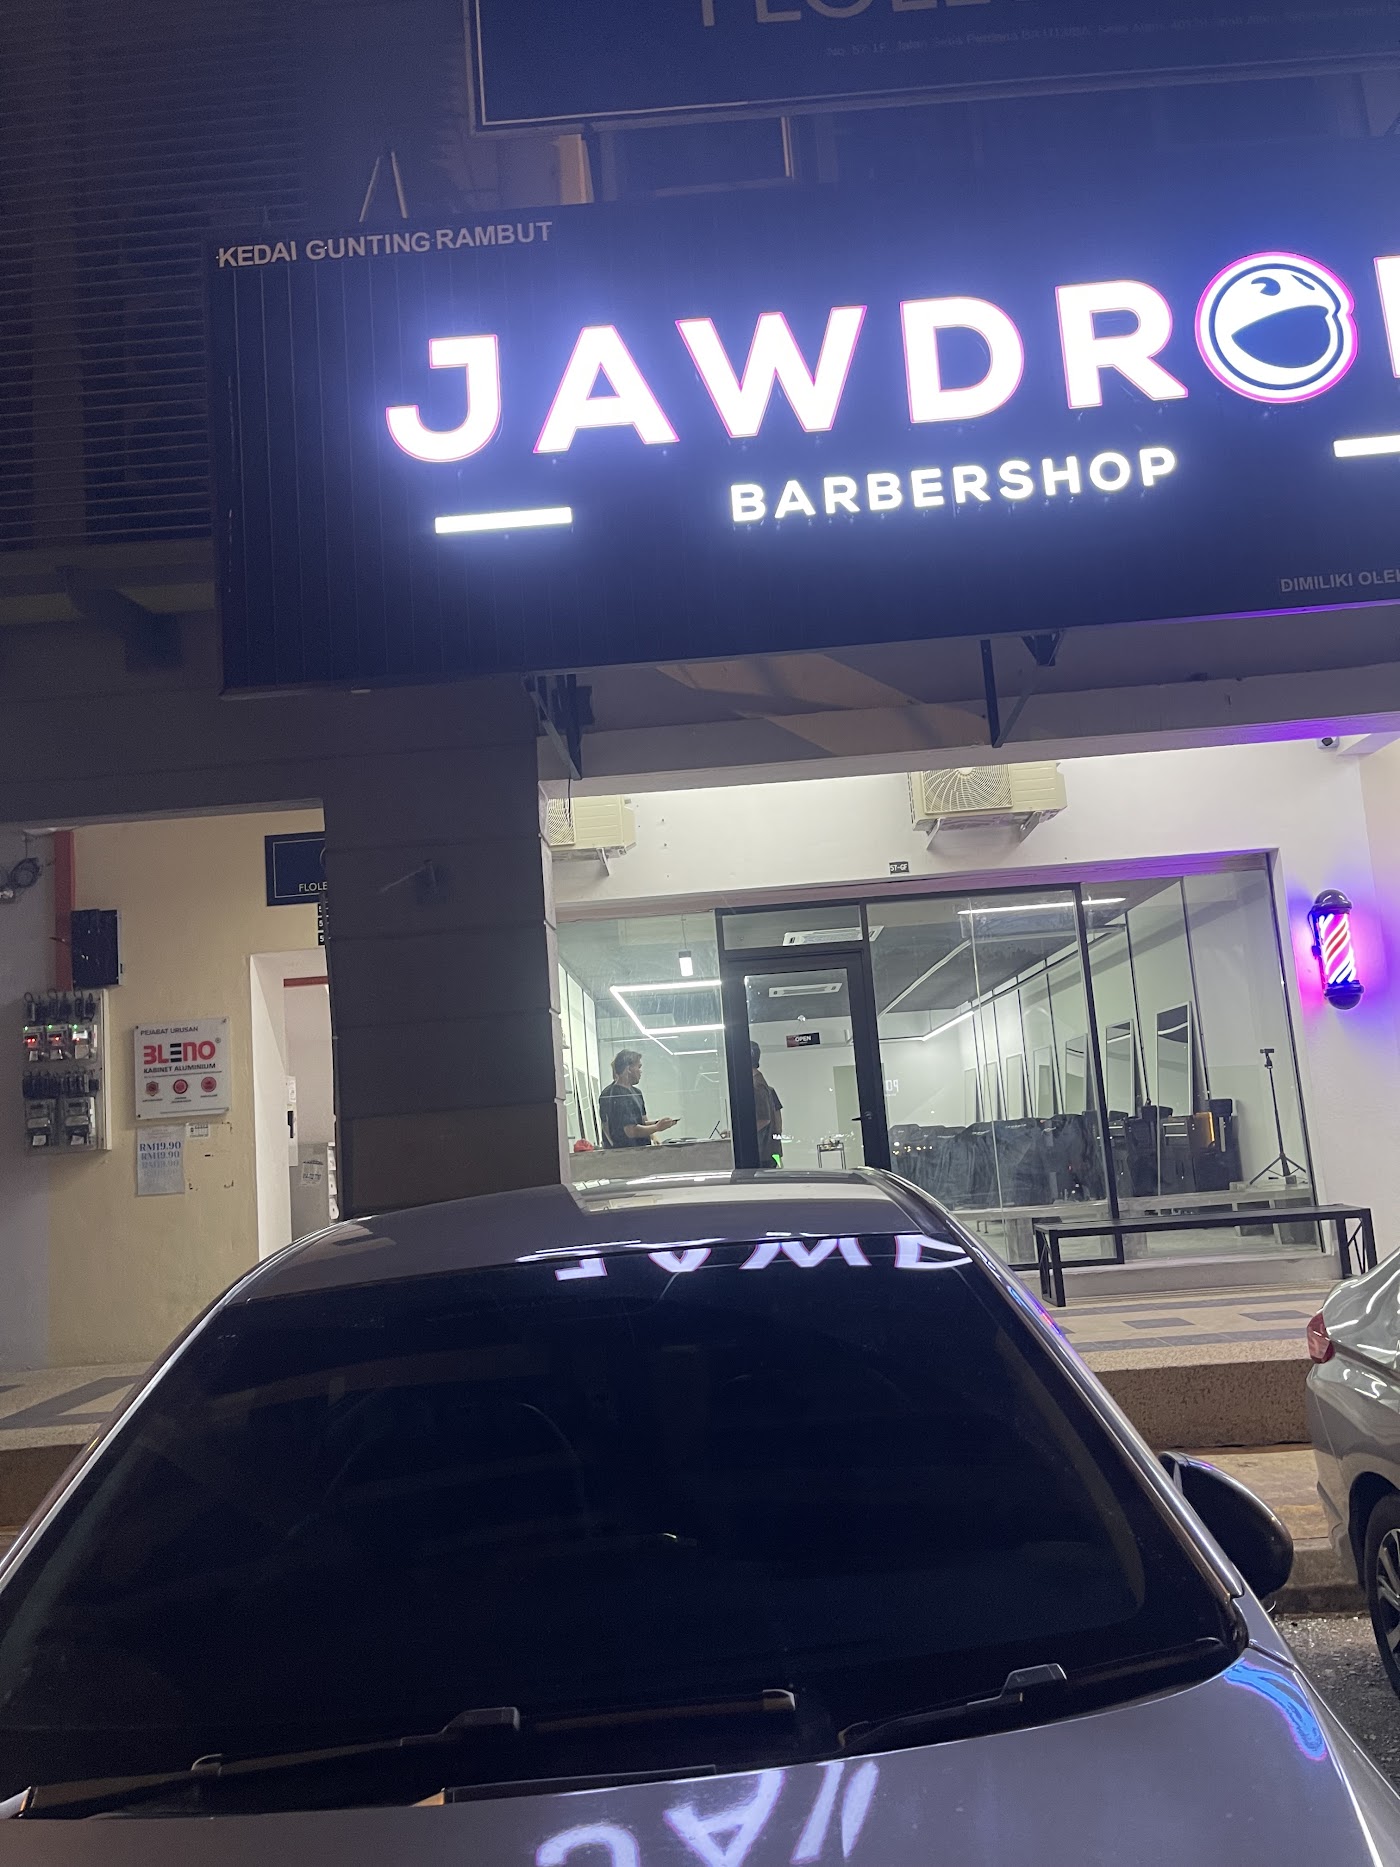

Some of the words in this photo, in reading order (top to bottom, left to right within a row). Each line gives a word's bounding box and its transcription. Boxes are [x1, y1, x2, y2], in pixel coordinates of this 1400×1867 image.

[219, 241, 296, 267] KEDAI
[306, 232, 430, 260] GUNTING
[436, 221, 552, 249] RAMBUT
[386, 251, 1400, 463] JAWDRO
[730, 447, 1177, 523] BARBERSHOP
[1281, 573, 1353, 592] DIMILIKI
[140, 1028, 168, 1036] PEJABAT
[143, 1040, 216, 1065] BLENO
[144, 1066, 172, 1074] KABINET
[174, 1063, 216, 1072] ALUMINIUM
[140, 1141, 181, 1152] RM19.90
[141, 1151, 180, 1160] RM19.90
